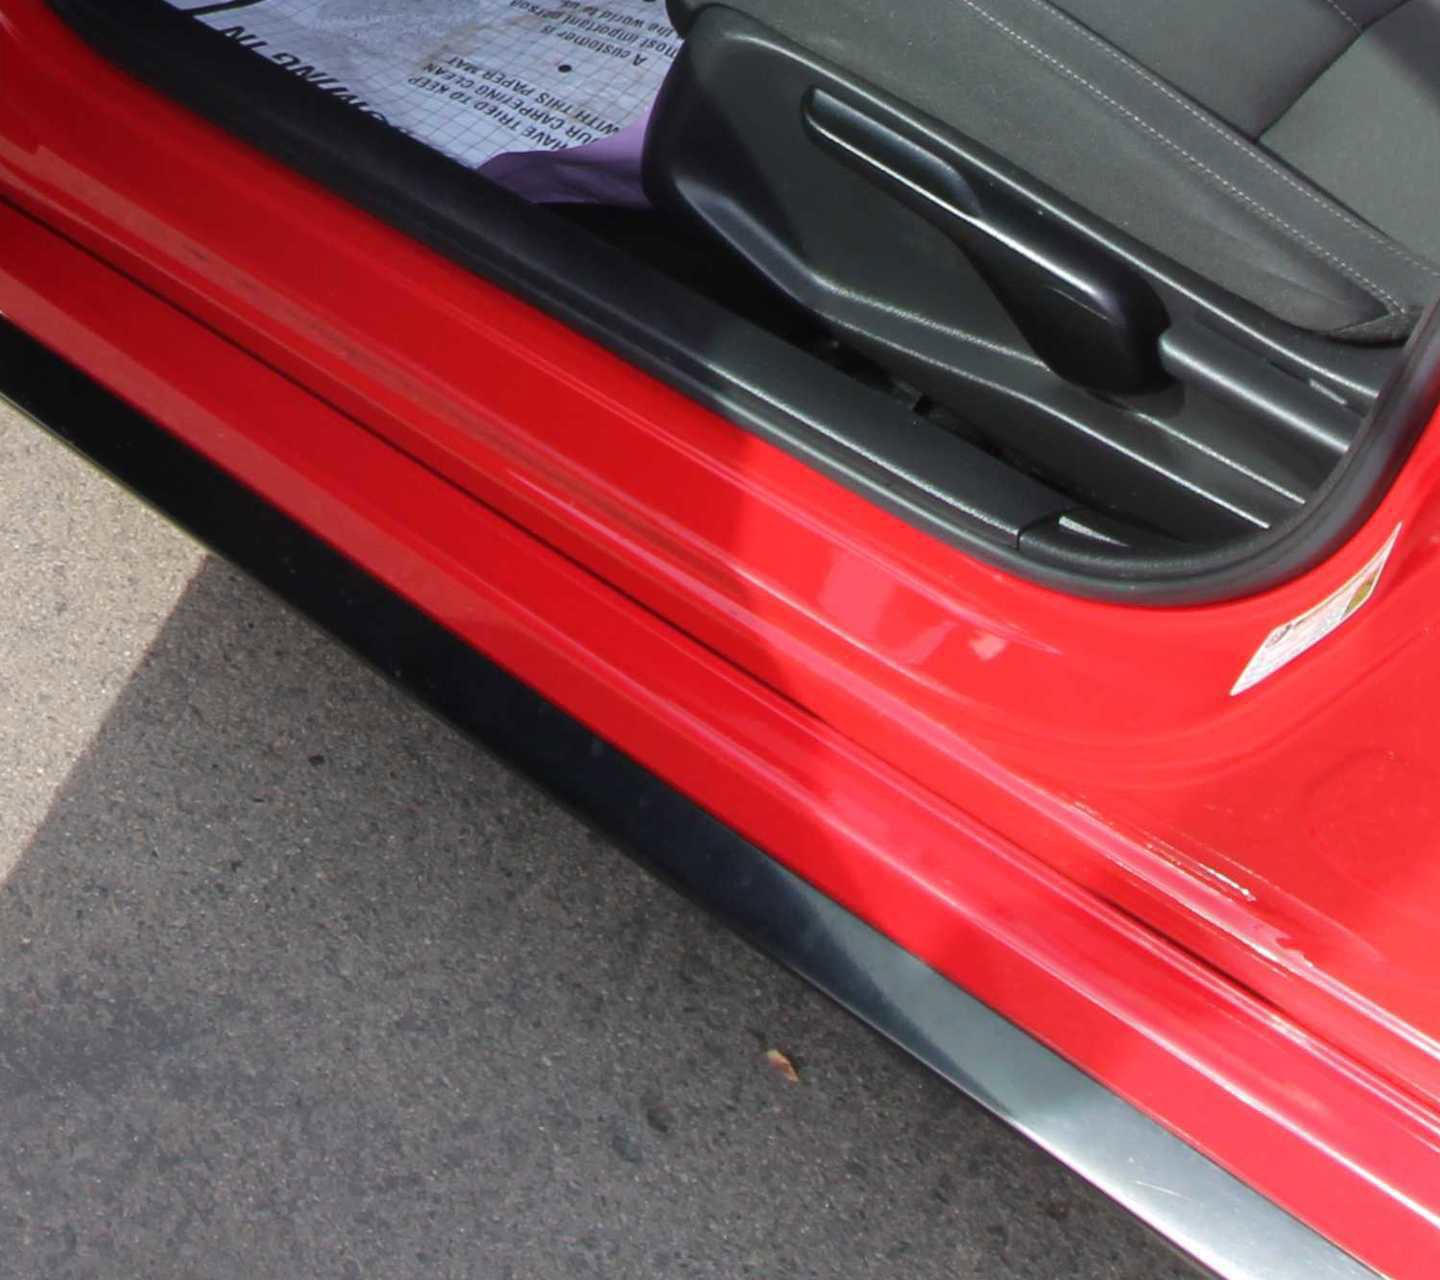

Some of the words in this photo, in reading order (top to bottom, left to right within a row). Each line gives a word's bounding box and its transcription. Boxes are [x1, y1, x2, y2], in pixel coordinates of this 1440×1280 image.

[561, 14, 640, 45] important
[599, 11, 644, 28] world
[557, 30, 631, 59] customer
[447, 55, 481, 75] MAT
[632, 54, 648, 67] A
[407, 76, 450, 95] KEEP
[422, 63, 475, 89] CLEAN
[485, 70, 536, 97] PAPER
[449, 91, 472, 105] TO
[477, 85, 565, 131] CARPETING
[535, 92, 573, 115] THIS
[473, 101, 521, 132] TRIED
[563, 125, 599, 144] UR
